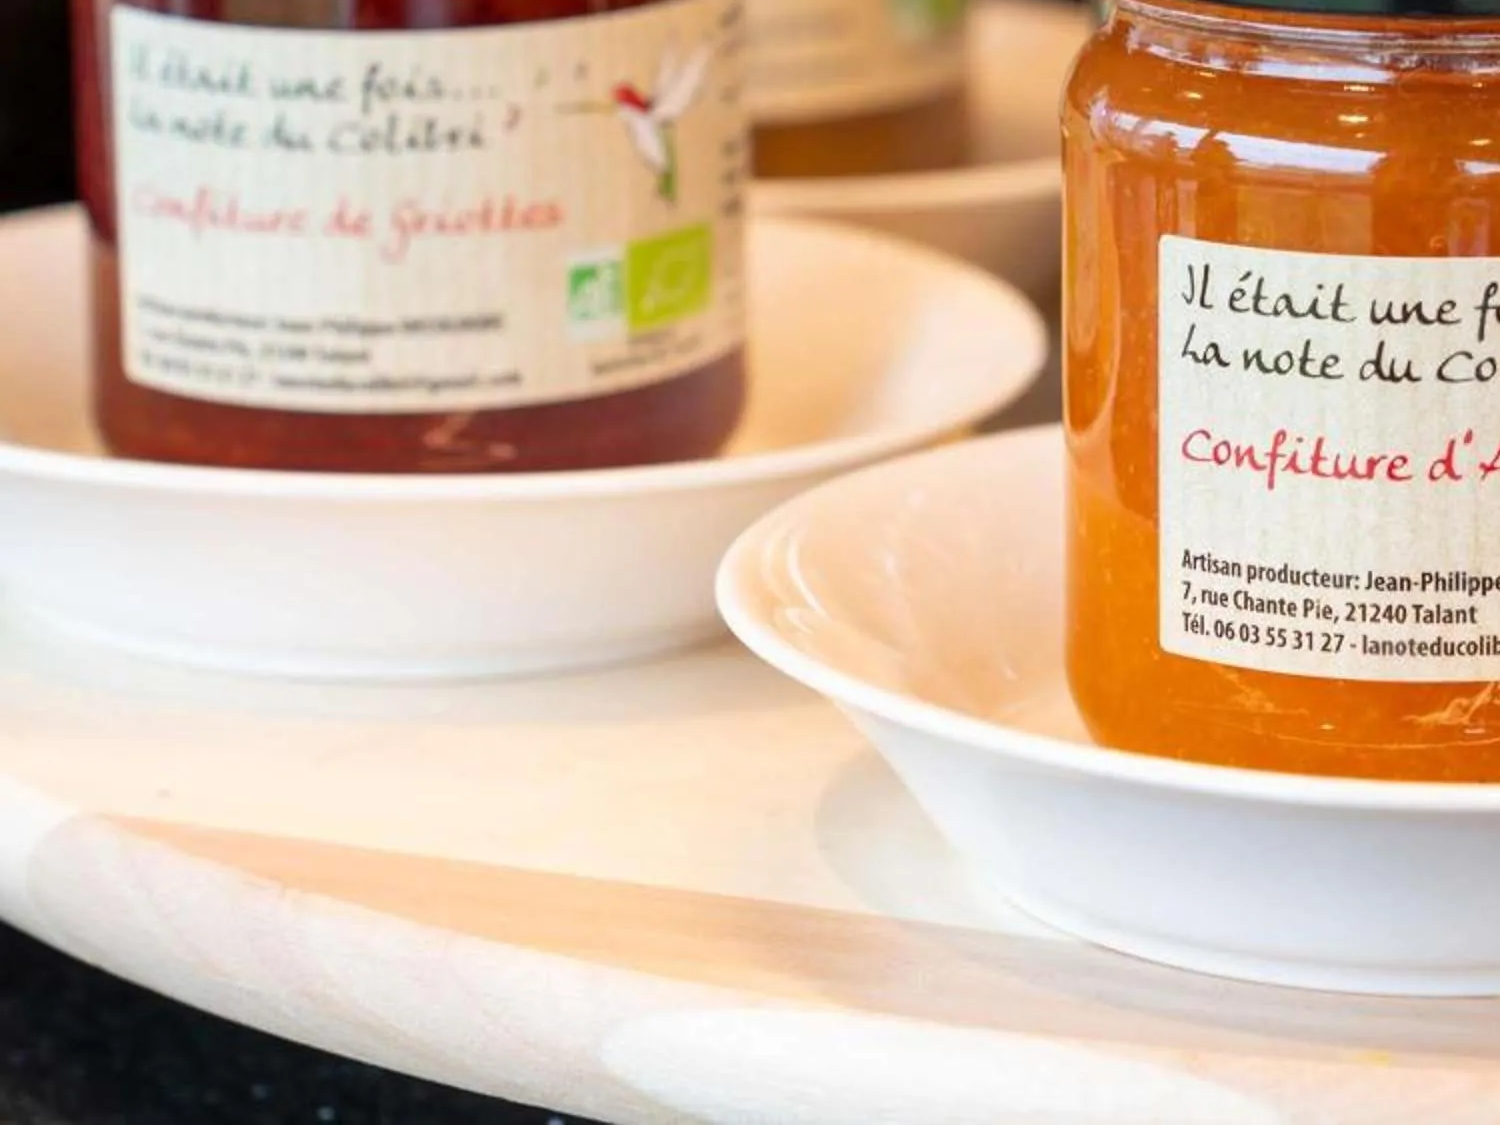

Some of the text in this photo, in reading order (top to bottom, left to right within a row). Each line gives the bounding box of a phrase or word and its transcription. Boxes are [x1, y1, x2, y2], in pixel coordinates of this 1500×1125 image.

[1229, 271, 1356, 322] était
[1370, 298, 1461, 325] une
[1182, 323, 1230, 367] La
[1243, 339, 1344, 379] note
[1359, 340, 1422, 382] du
[1182, 429, 1413, 490] Confiture
[1182, 549, 1242, 578] Artisan
[1247, 563, 1360, 591] producteur:
[1183, 581, 1478, 624] 7, rue Chante Pie, 21240 Talant
[1182, 612, 1210, 636] Tél.
[1214, 619, 1235, 640] 06
[1239, 624, 1260, 644] 03
[1265, 626, 1288, 649] 55
[1292, 630, 1314, 651] 31
[1321, 632, 1345, 653] 27
